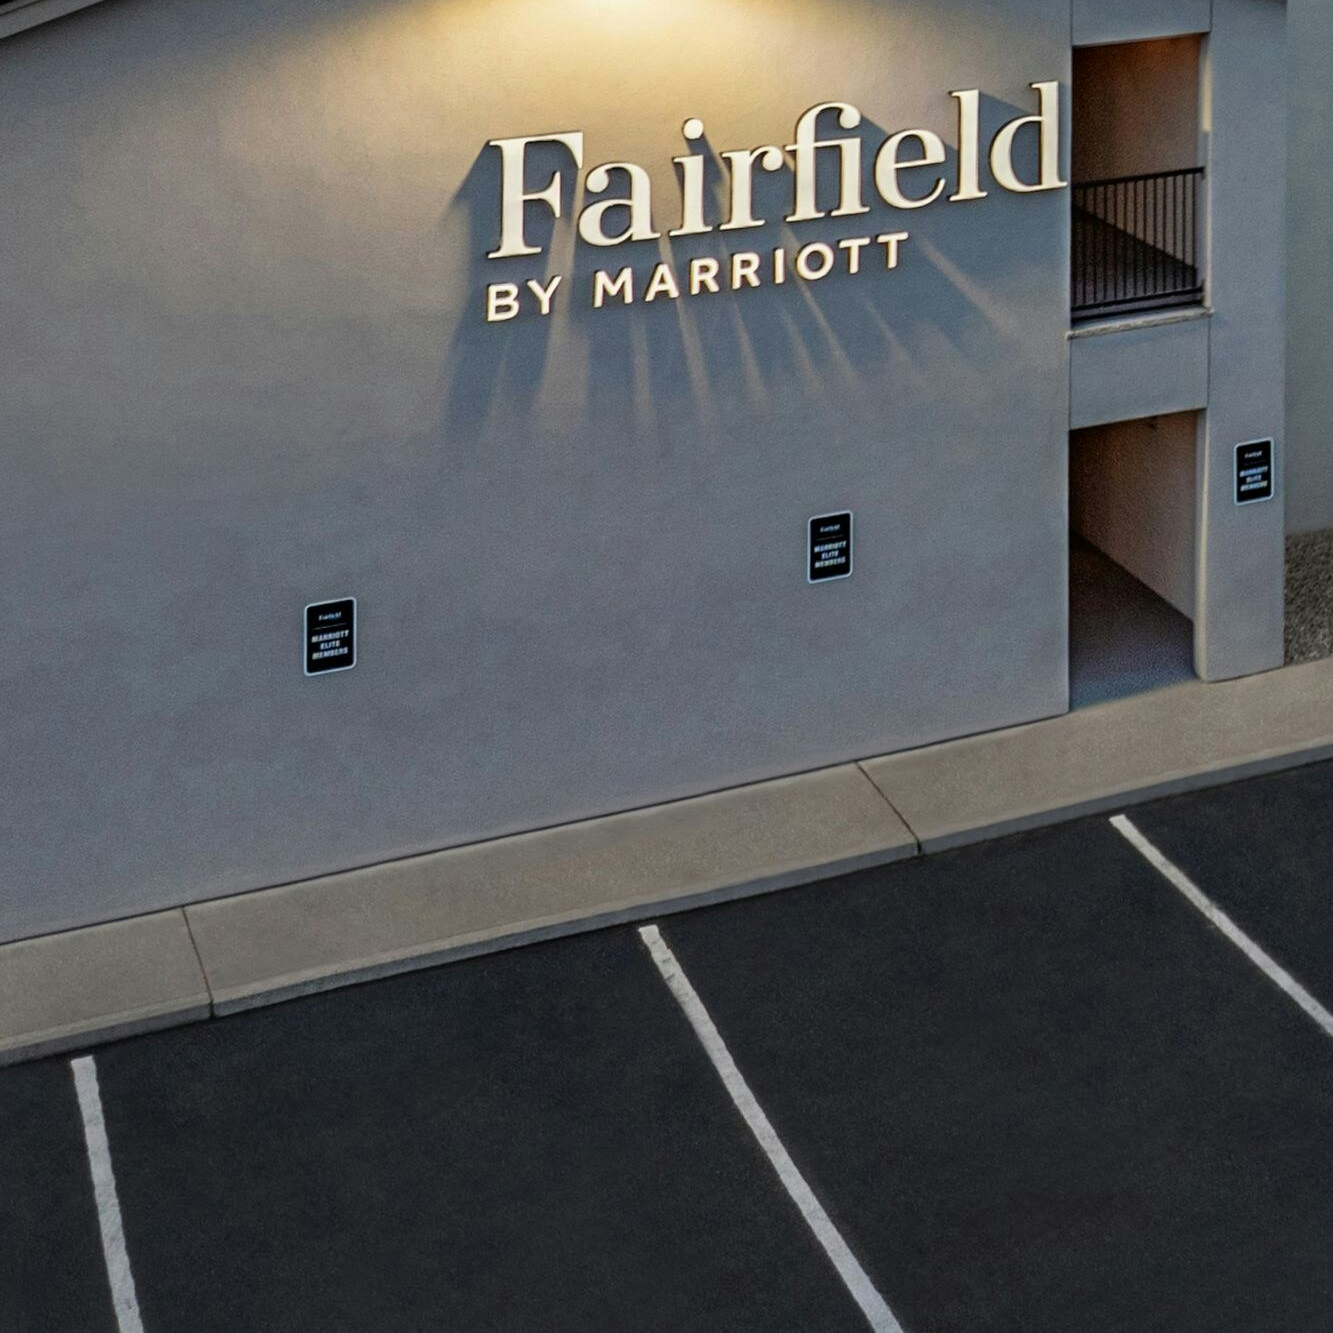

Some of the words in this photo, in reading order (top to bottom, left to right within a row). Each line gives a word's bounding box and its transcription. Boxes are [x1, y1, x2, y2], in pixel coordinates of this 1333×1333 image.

[485, 80, 1068, 259] Fairfield
[486, 276, 562, 323] BY
[593, 232, 909, 308] MARRIOTT
[320, 640, 340, 650] ELITE
